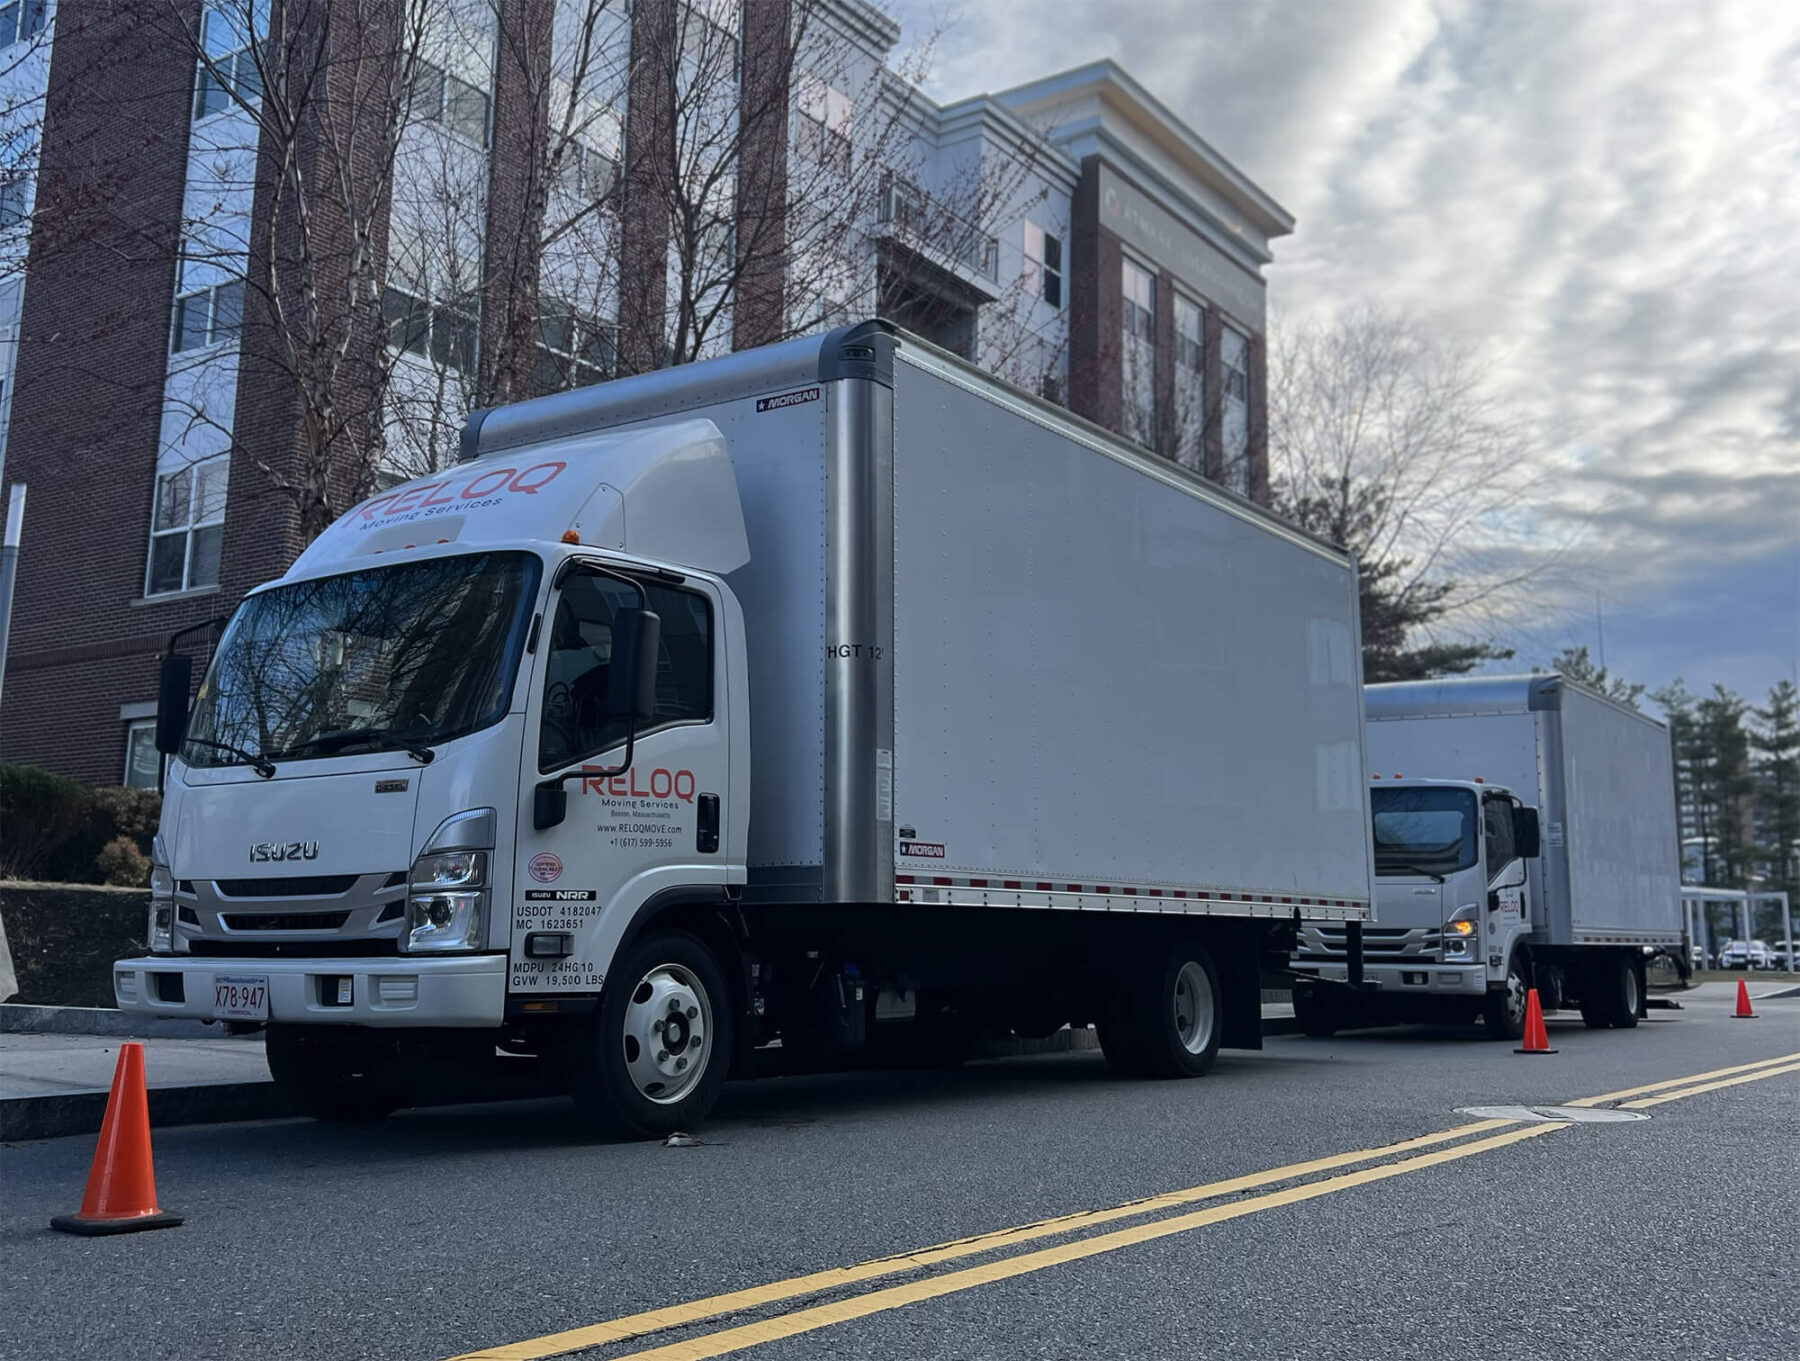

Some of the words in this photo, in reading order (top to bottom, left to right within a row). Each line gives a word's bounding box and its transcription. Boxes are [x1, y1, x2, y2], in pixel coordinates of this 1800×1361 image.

[767, 388, 818, 409] MORGAN
[341, 461, 567, 529] RELOQ
[359, 511, 420, 532] Moving
[424, 497, 503, 517] Services
[827, 644, 863, 659] HGT
[581, 764, 696, 804] RELOQ
[601, 798, 637, 809] Moving
[640, 799, 679, 809] Services
[597, 823, 682, 834] www.RELOQMOVE.com
[620, 837, 638, 848] (617)
[640, 838, 673, 848] 599-5956
[249, 840, 320, 863] ISUZU
[908, 843, 944, 858] MORGAN
[556, 891, 589, 900] NRR
[516, 906, 553, 917] USDOT
[560, 906, 602, 916] 4182047
[516, 920, 533, 929] MC
[541, 919, 583, 929] 1623651
[513, 962, 545, 973] MDPU
[512, 976, 538, 987] GVW
[585, 975, 605, 985] LBS
